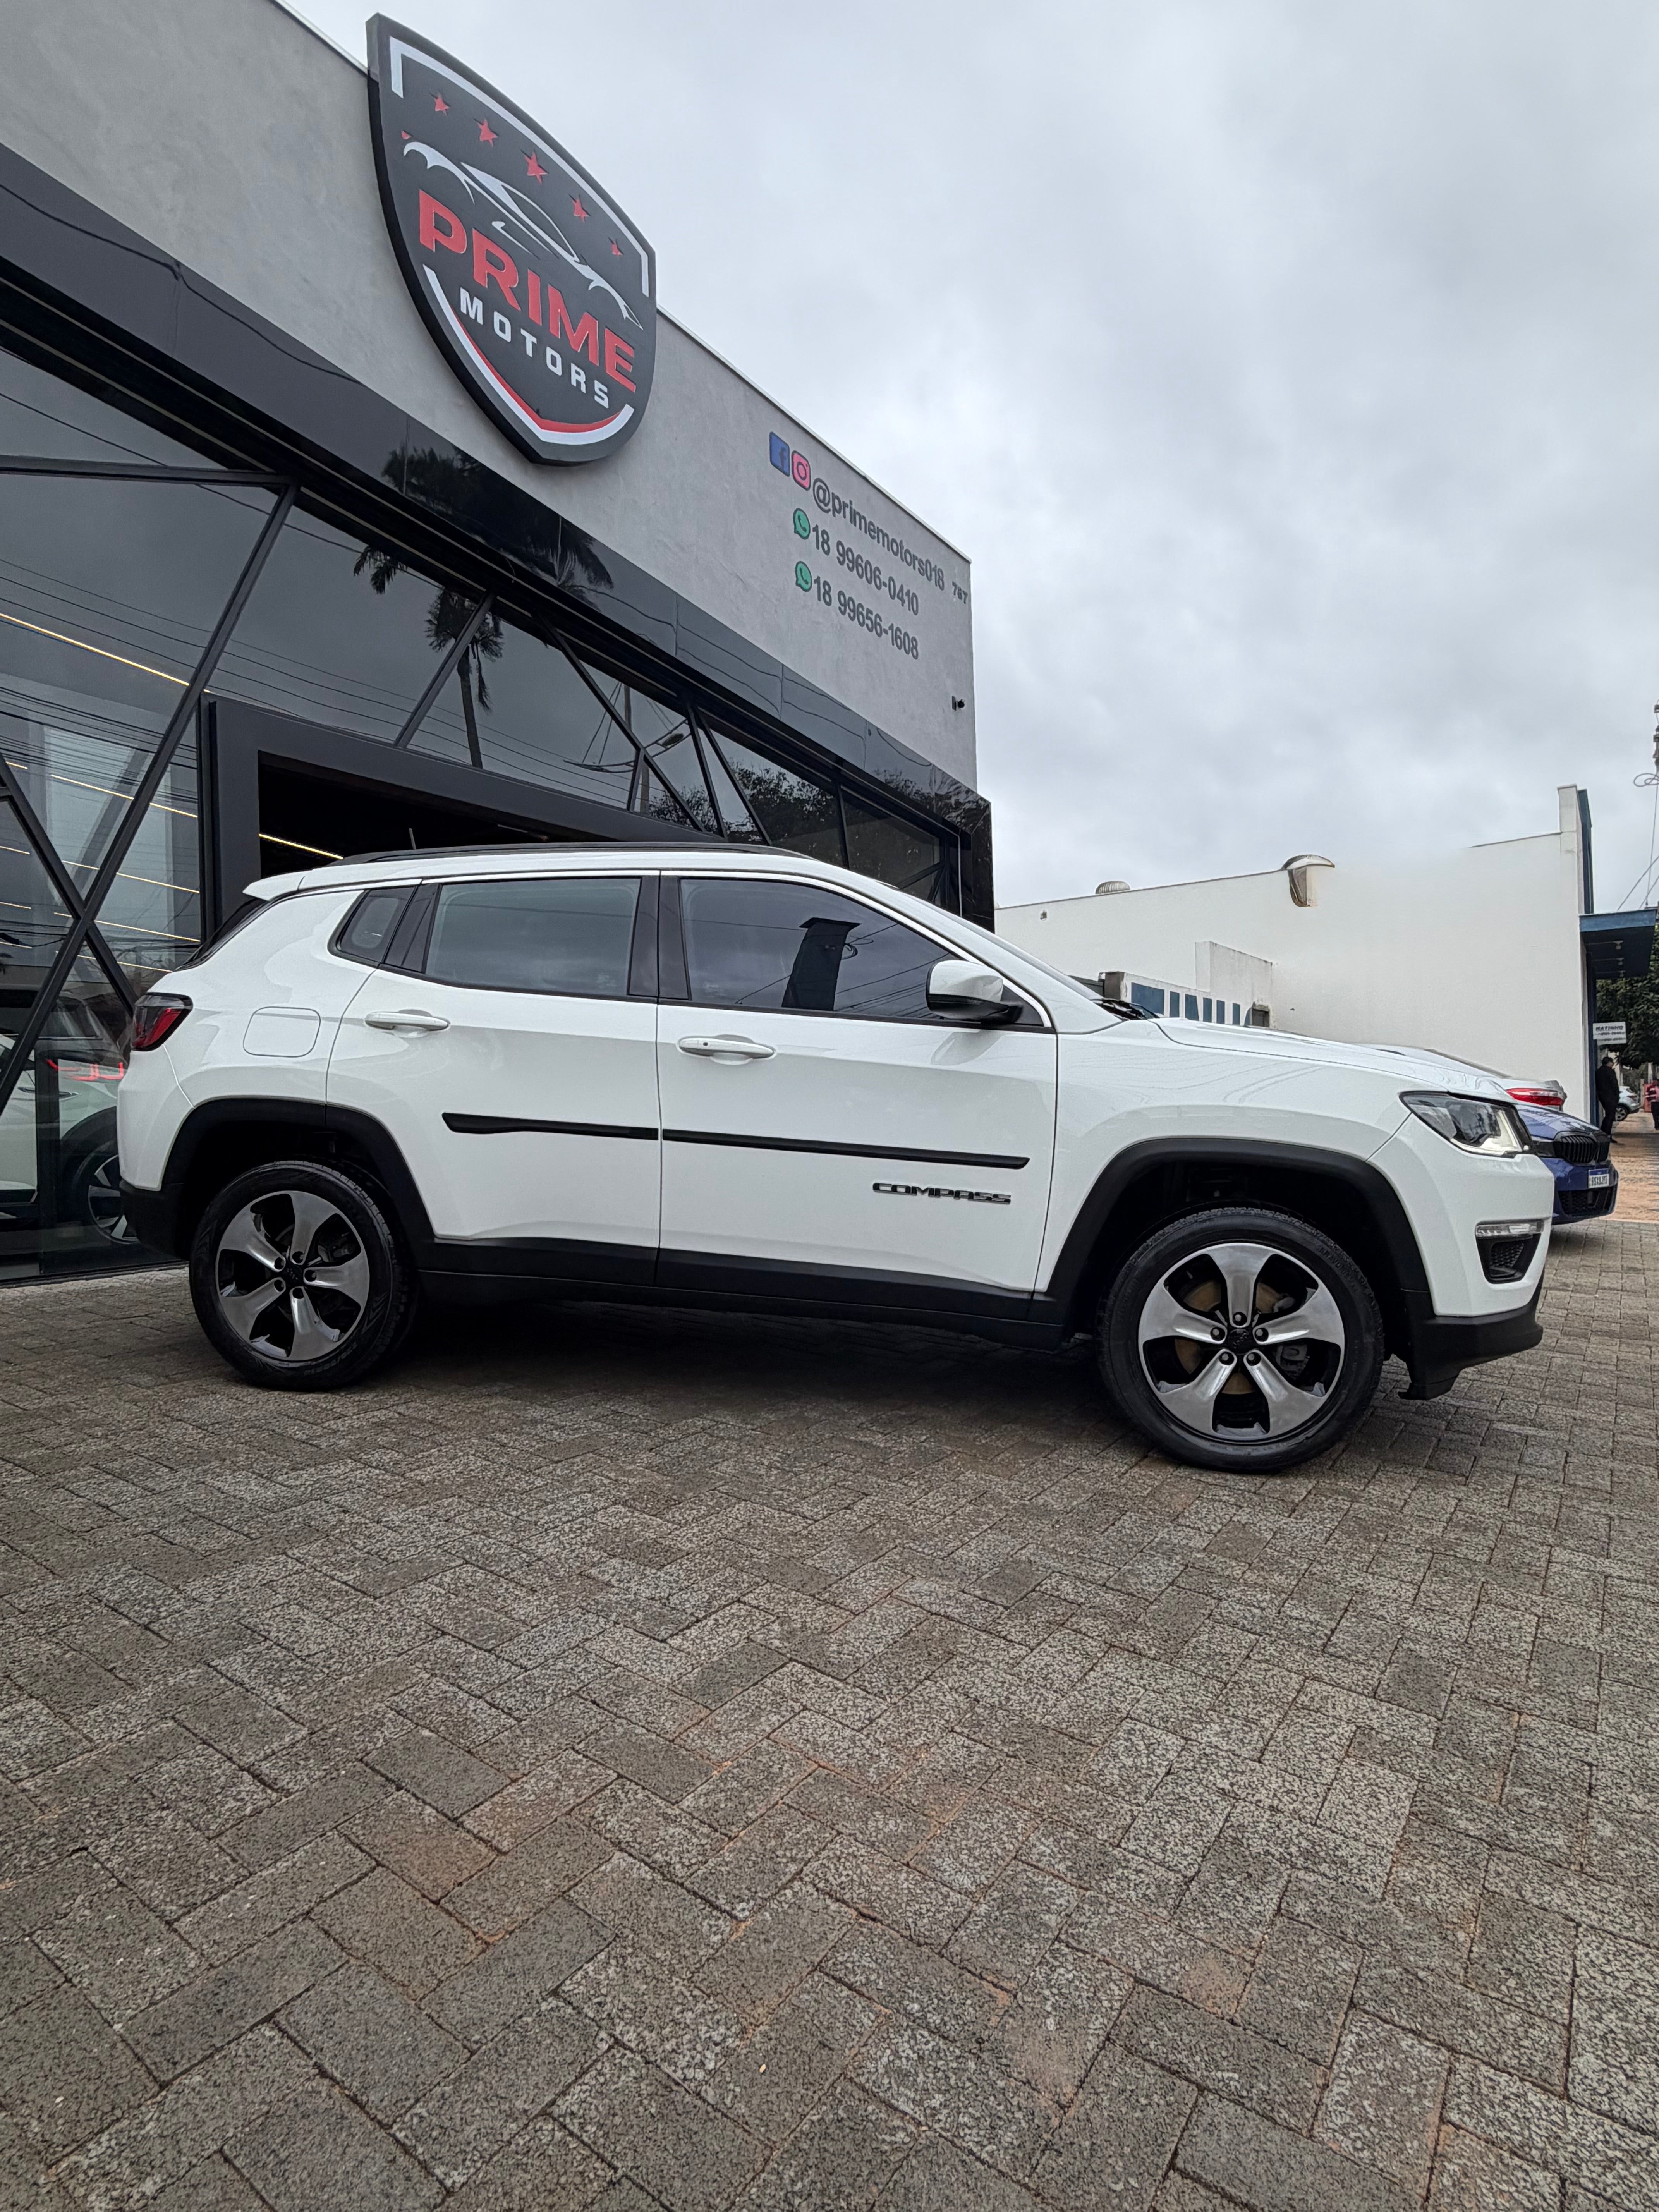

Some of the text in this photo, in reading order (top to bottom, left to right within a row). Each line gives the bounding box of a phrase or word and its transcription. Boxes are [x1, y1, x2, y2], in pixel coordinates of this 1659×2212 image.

[419, 189, 636, 393] PRIME
[460, 287, 610, 409] MOTORS
[812, 524, 919, 615] 18 99606-0410
[813, 478, 945, 591] @primemotors018
[814, 576, 919, 660] 18 99656-1608
[873, 1183, 1011, 1204] COMPASS
